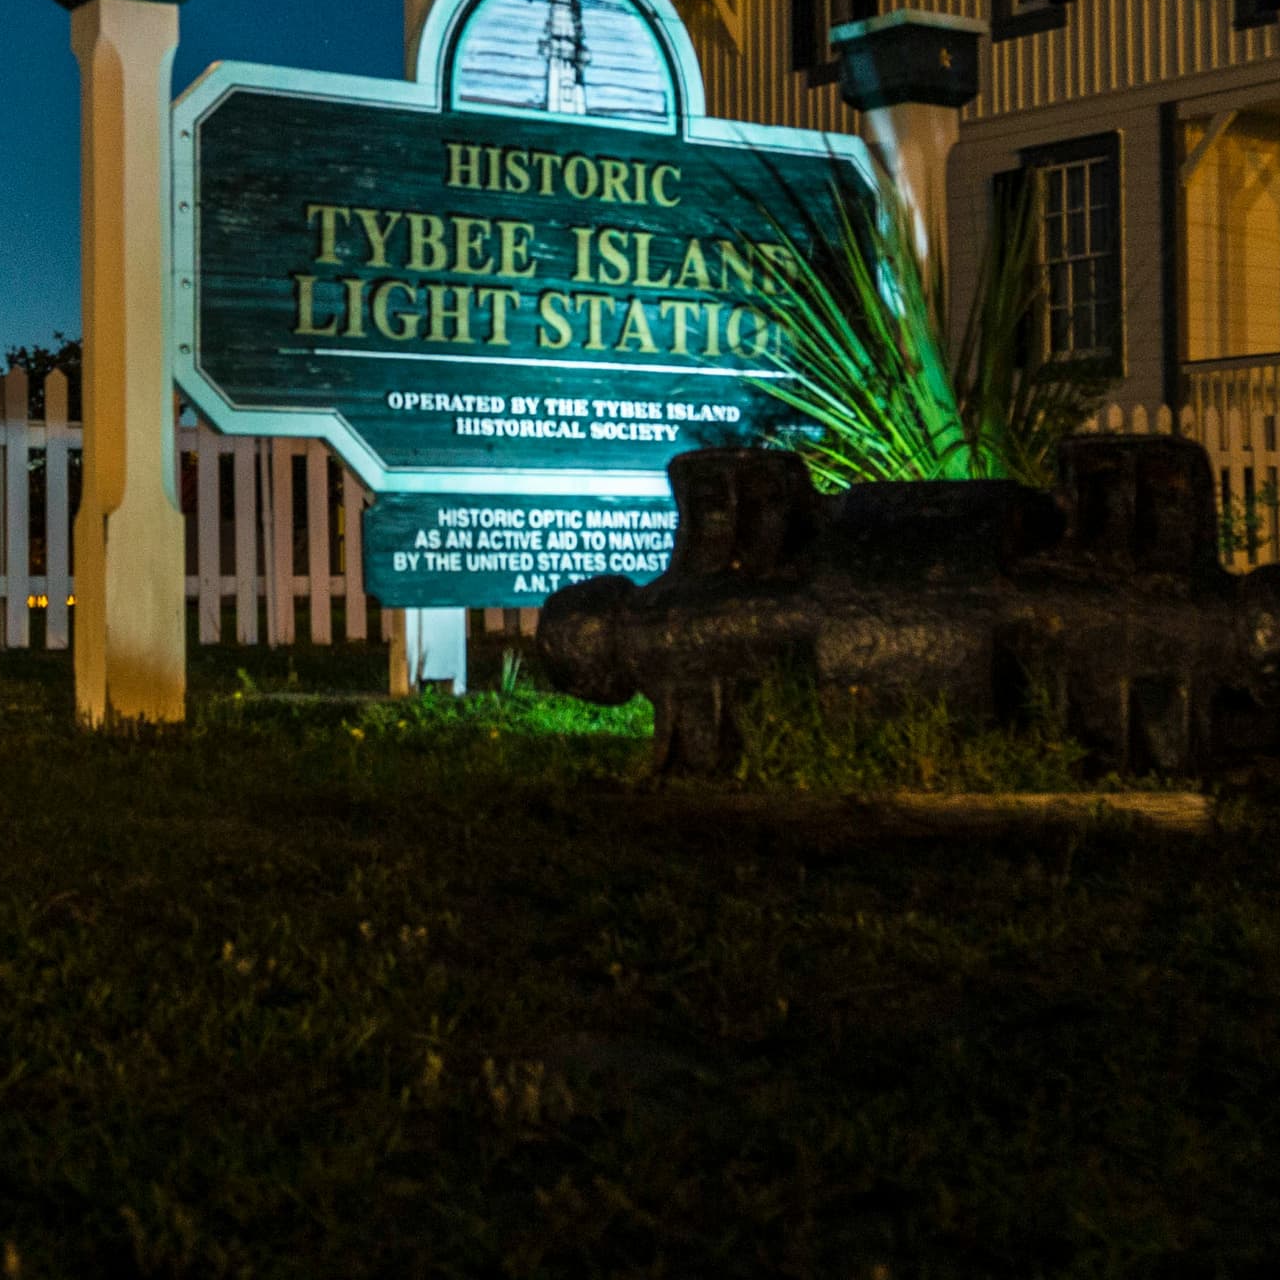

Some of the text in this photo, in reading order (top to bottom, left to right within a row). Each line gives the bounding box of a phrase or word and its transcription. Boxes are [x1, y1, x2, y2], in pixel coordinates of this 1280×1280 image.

[446, 143, 681, 207] HISTORIC
[307, 204, 538, 278] TYBEE
[294, 275, 521, 346] LIGHT
[388, 392, 741, 423] OPERATED BY THE TYBEE ISLAND
[456, 417, 679, 441] HISTORICAL SOCIETY
[438, 508, 679, 530] HISTORIC OPTIC MAINTAINE
[415, 529, 674, 550] AS AN ACTIVE AID TO NAVIGA
[393, 552, 669, 572] BY THE UNITED STATES COAST
